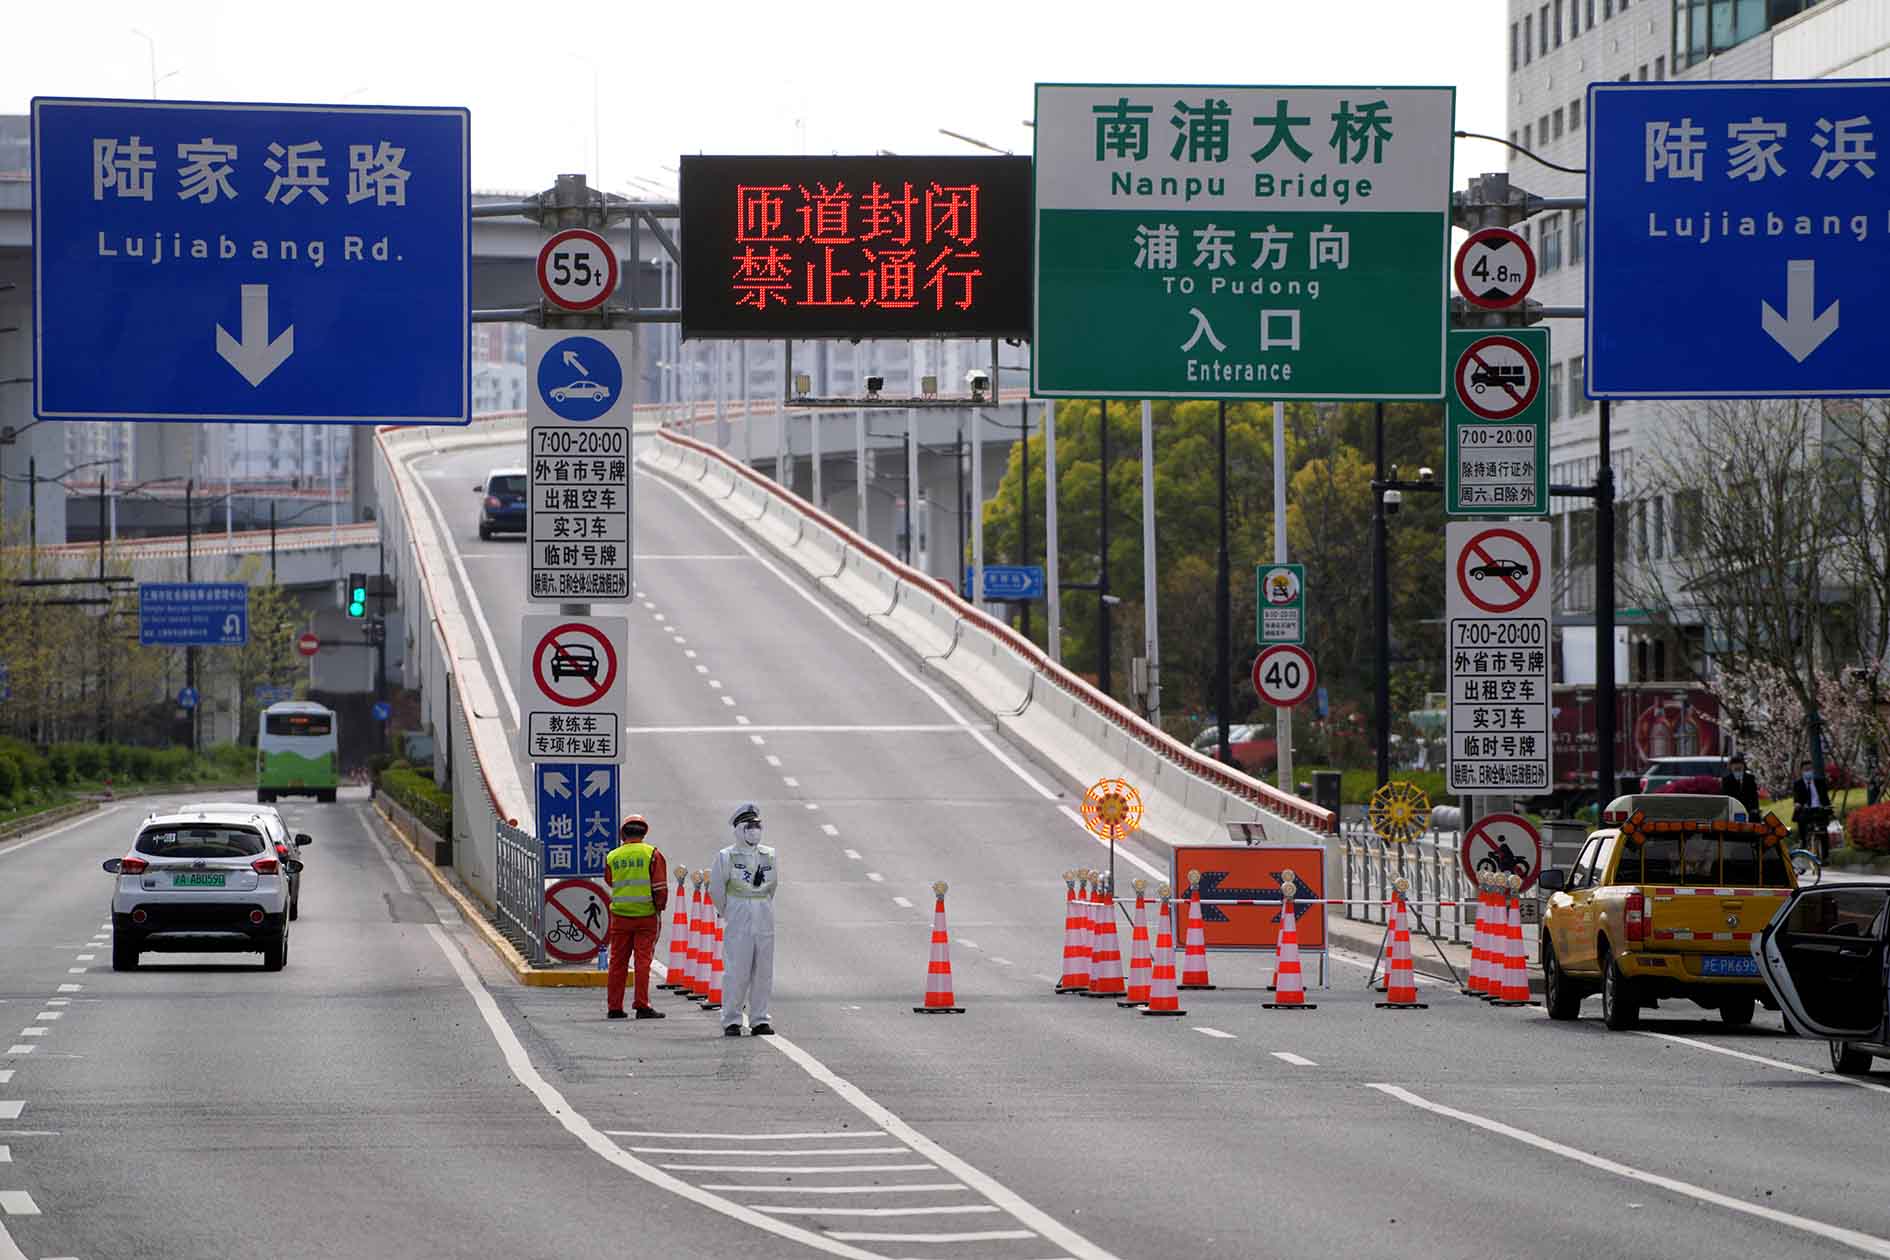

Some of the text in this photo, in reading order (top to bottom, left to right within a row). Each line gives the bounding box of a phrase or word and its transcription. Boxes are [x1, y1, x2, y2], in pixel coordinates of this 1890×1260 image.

[1092, 98, 1393, 165] 南浦大桥
[1645, 115, 1876, 182] 陆家浜
[93, 136, 412, 206] 陆家浜路
[1111, 172, 1373, 205] Nanpu Bridge
[735, 181, 980, 247] 匝道封闭
[1649, 211, 1868, 243] Lujiabang
[99, 231, 403, 267] Lujiabang Rd.
[1133, 224, 1351, 271] 浦东方向
[732, 246, 983, 310] 禁止通行
[1471, 255, 1522, 284] 4.8m
[1211, 277, 1321, 299] Pudong
[1181, 307, 1301, 352] 入口
[1187, 359, 1294, 382] Enterance
[538, 432, 622, 452] 7:00-20:00
[535, 459, 625, 481] 外省市号牌
[1462, 461, 1534, 477] 除持通行证外
[544, 488, 617, 509] 出租空车
[1461, 486, 1534, 502] 周六、日除外
[553, 516, 608, 538] 实习车
[544, 544, 617, 566] 临时号牌
[1458, 623, 1541, 644] 7:00-20:00
[1454, 651, 1545, 673] 外省市号牌
[1265, 661, 1301, 689] 40
[1464, 680, 1535, 701] 出租空车
[549, 715, 597, 732] 教练车
[1473, 707, 1526, 729] 实习车
[535, 736, 611, 754] 专项作业车
[1464, 735, 1536, 757] 临时号牌
[547, 813, 574, 870] 地面
[584, 810, 611, 869] 大桥
